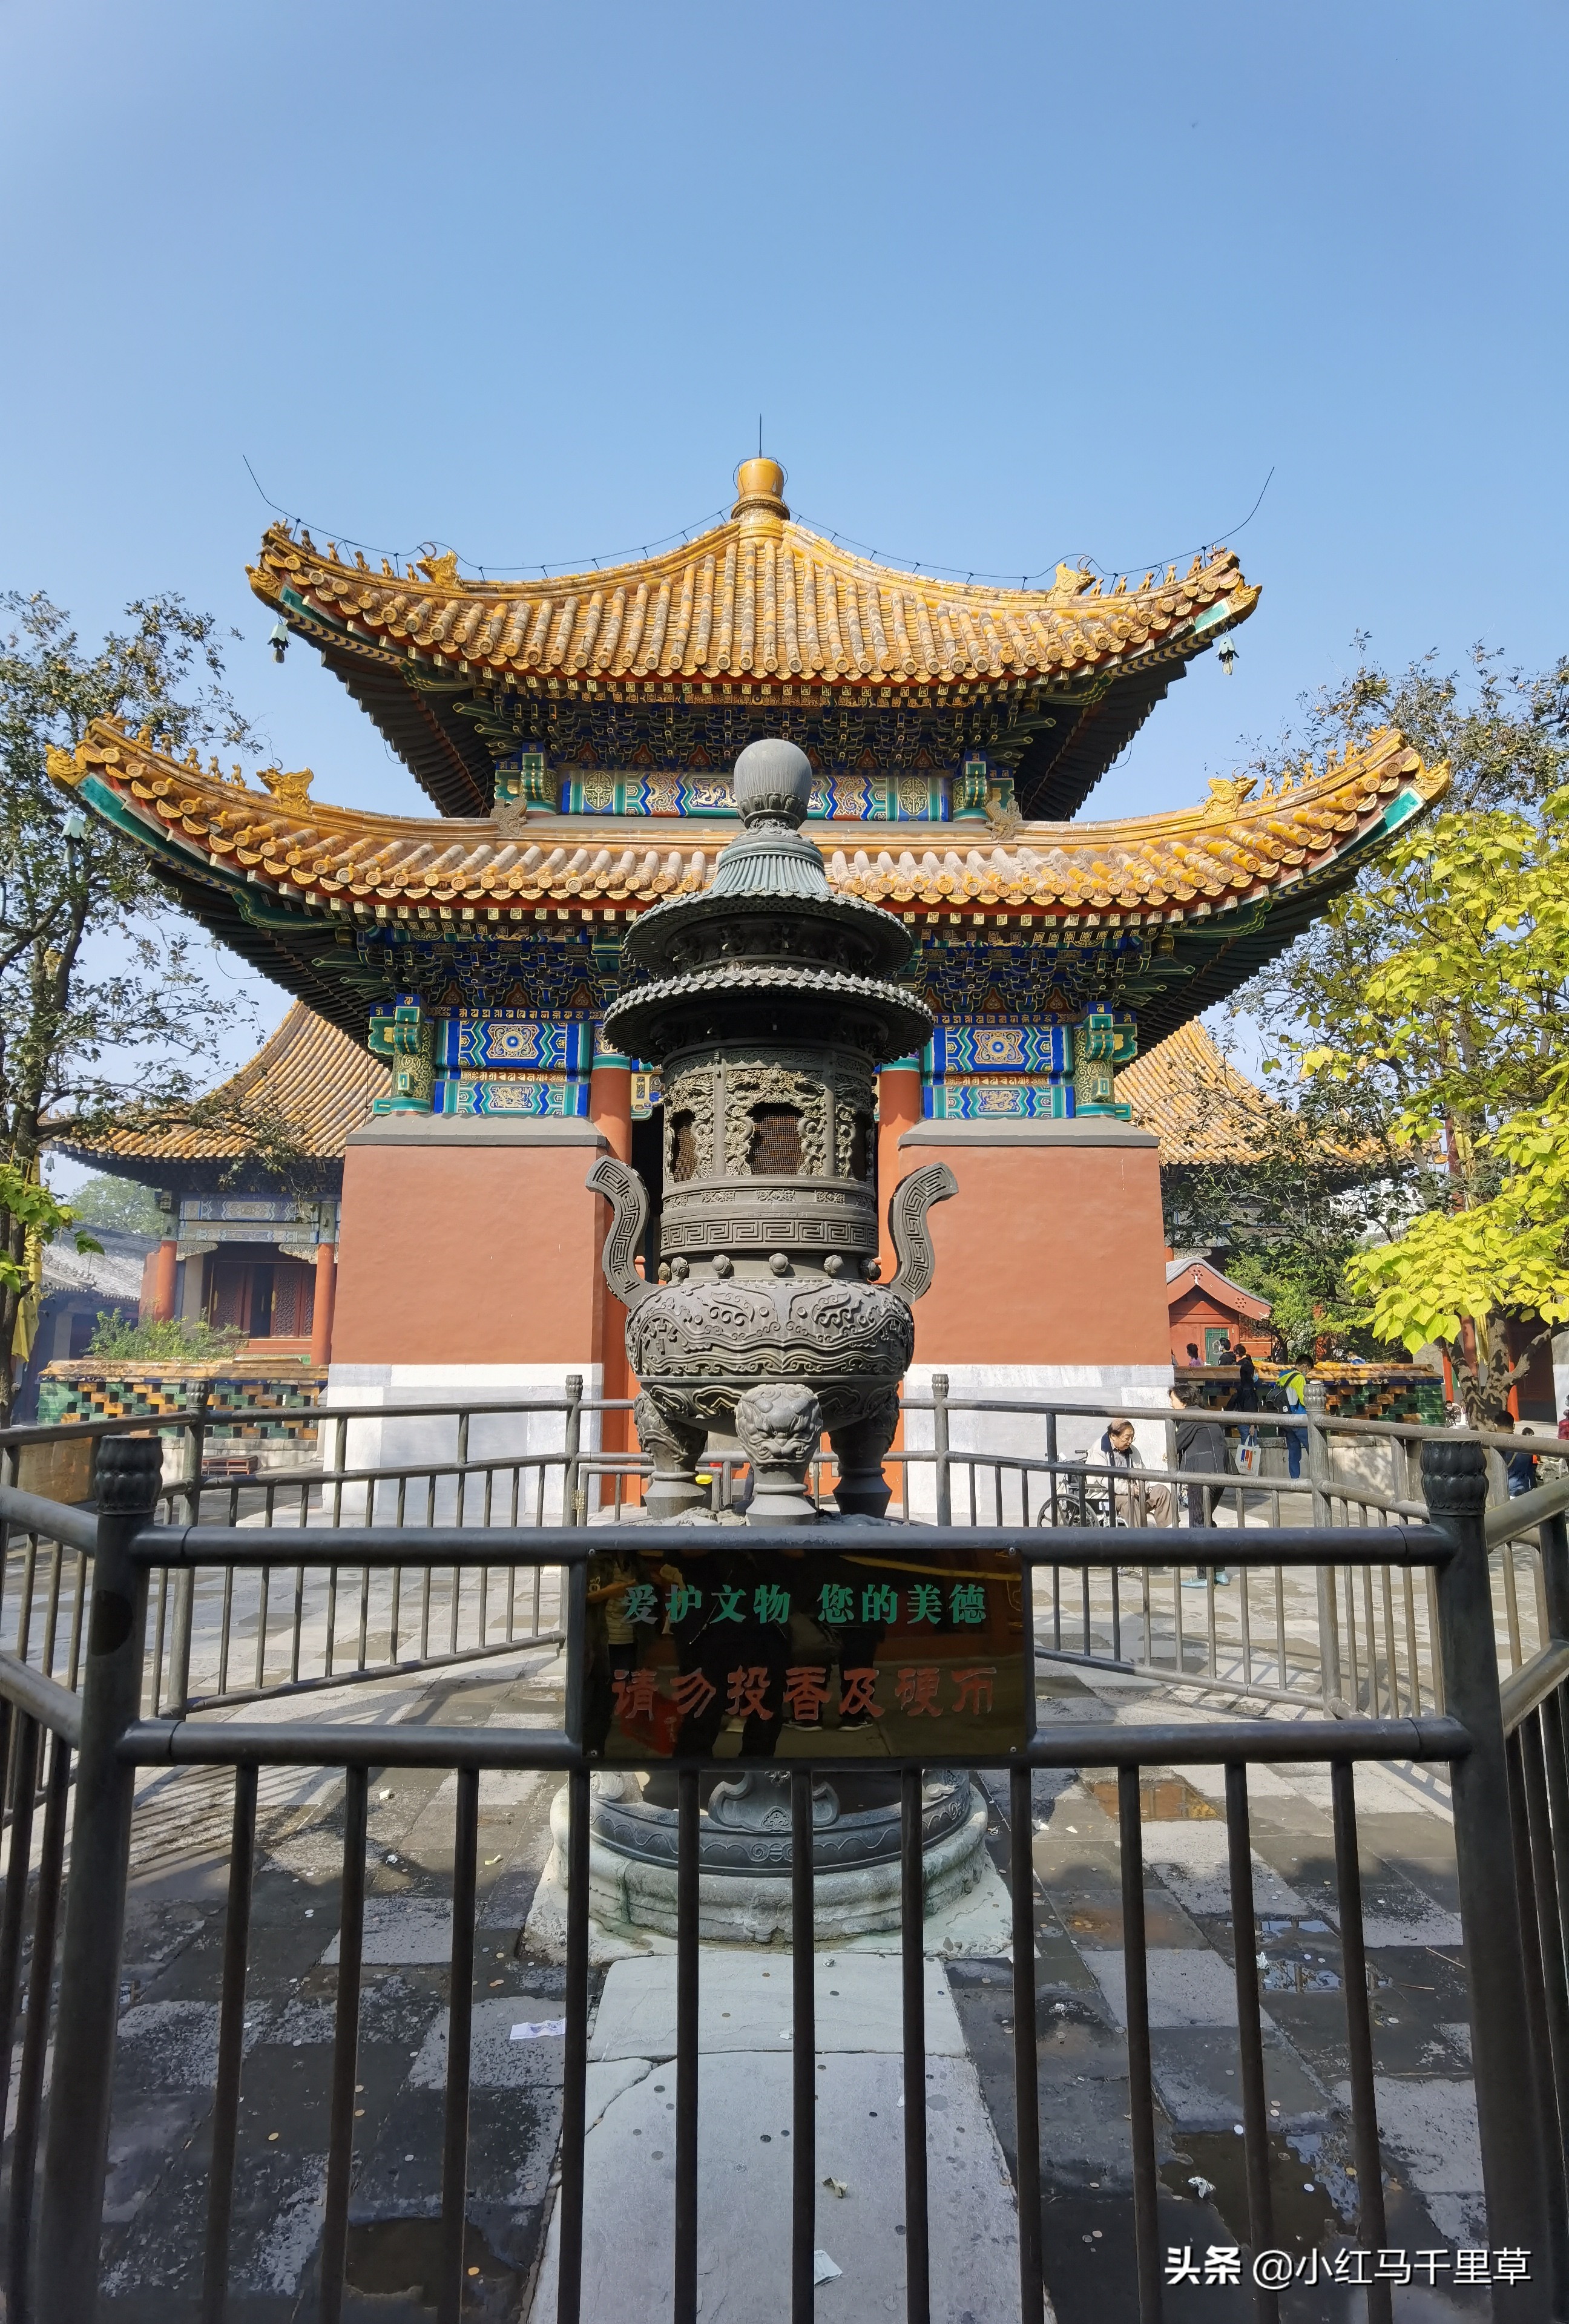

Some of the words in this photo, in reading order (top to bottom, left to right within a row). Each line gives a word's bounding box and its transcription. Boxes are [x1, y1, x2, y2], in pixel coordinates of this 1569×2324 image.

[621, 1583, 791, 1625] 爱护文物
[817, 1583, 987, 1625] 您的美德
[611, 1665, 998, 1721] 请勿投香及硬币
